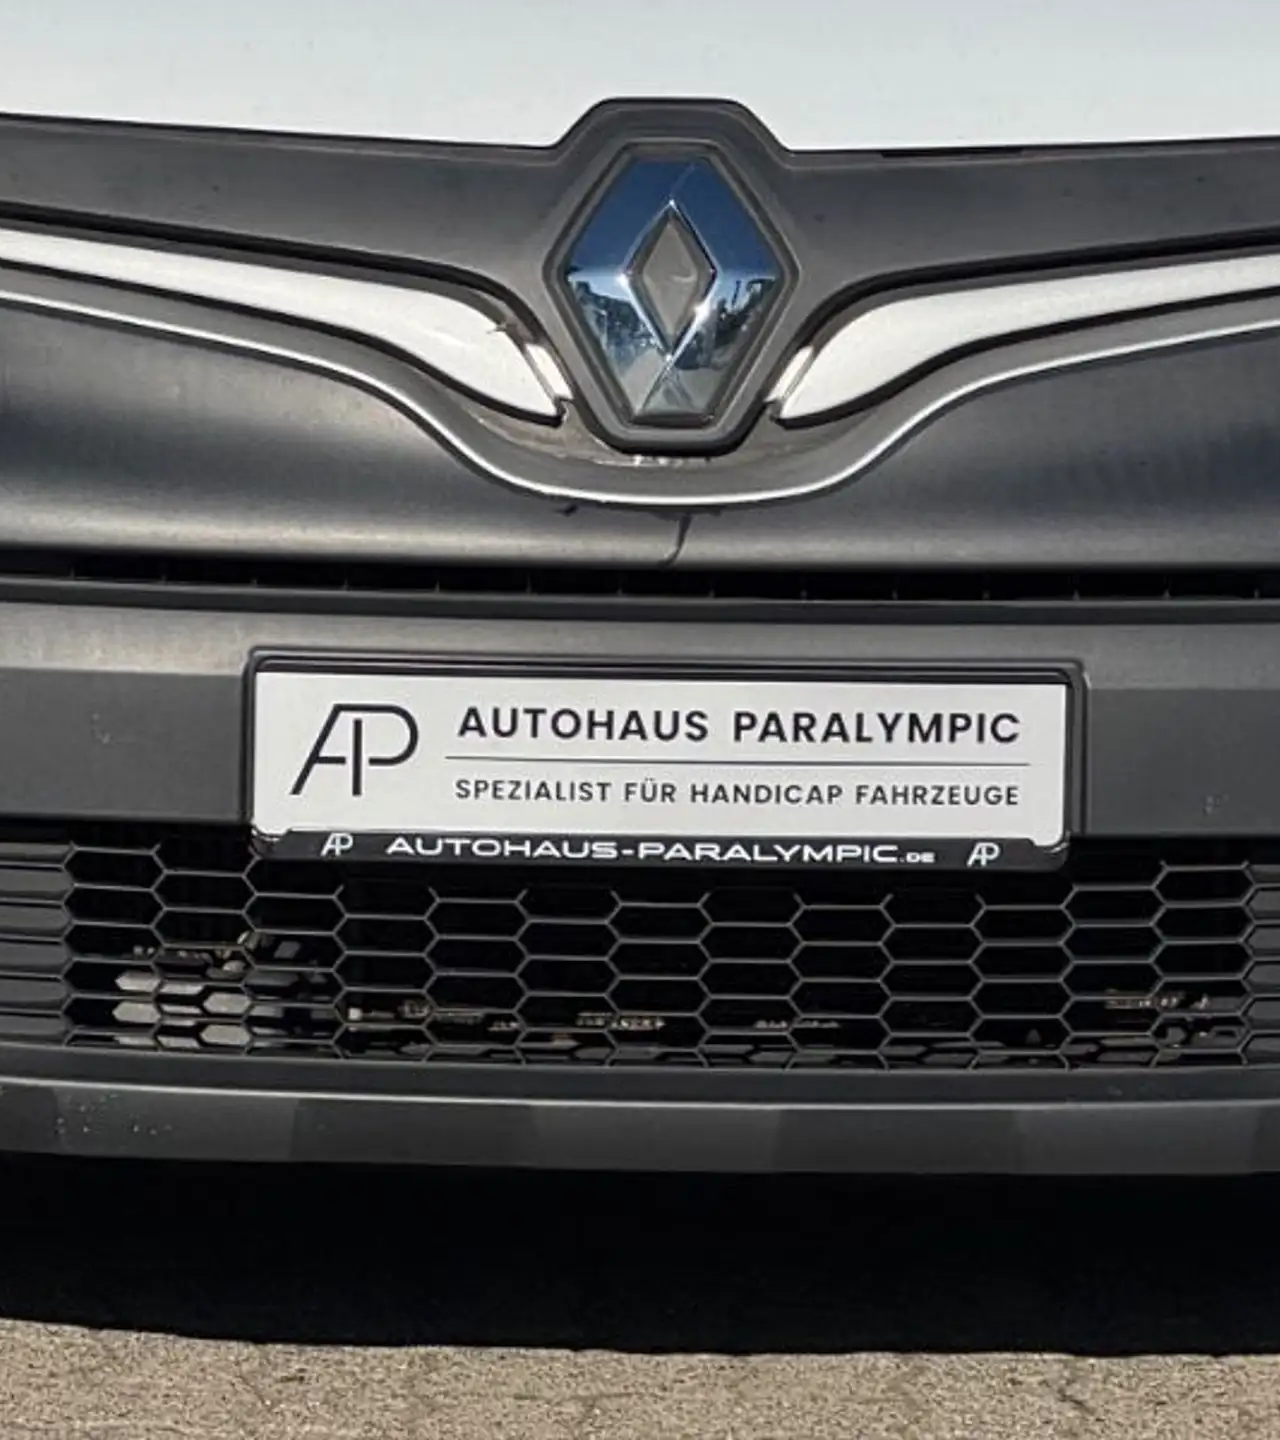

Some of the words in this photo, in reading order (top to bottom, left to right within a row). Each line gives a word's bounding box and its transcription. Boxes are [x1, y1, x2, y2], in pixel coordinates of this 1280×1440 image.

[458, 706, 708, 742] AUTOHAUS
[733, 712, 1020, 744] PARALYMPIC
[456, 779, 611, 802] SPEZIALIST
[625, 777, 676, 803] FÜR
[690, 783, 843, 805] HANDICAP
[856, 785, 1019, 806] FAHRZEUGE
